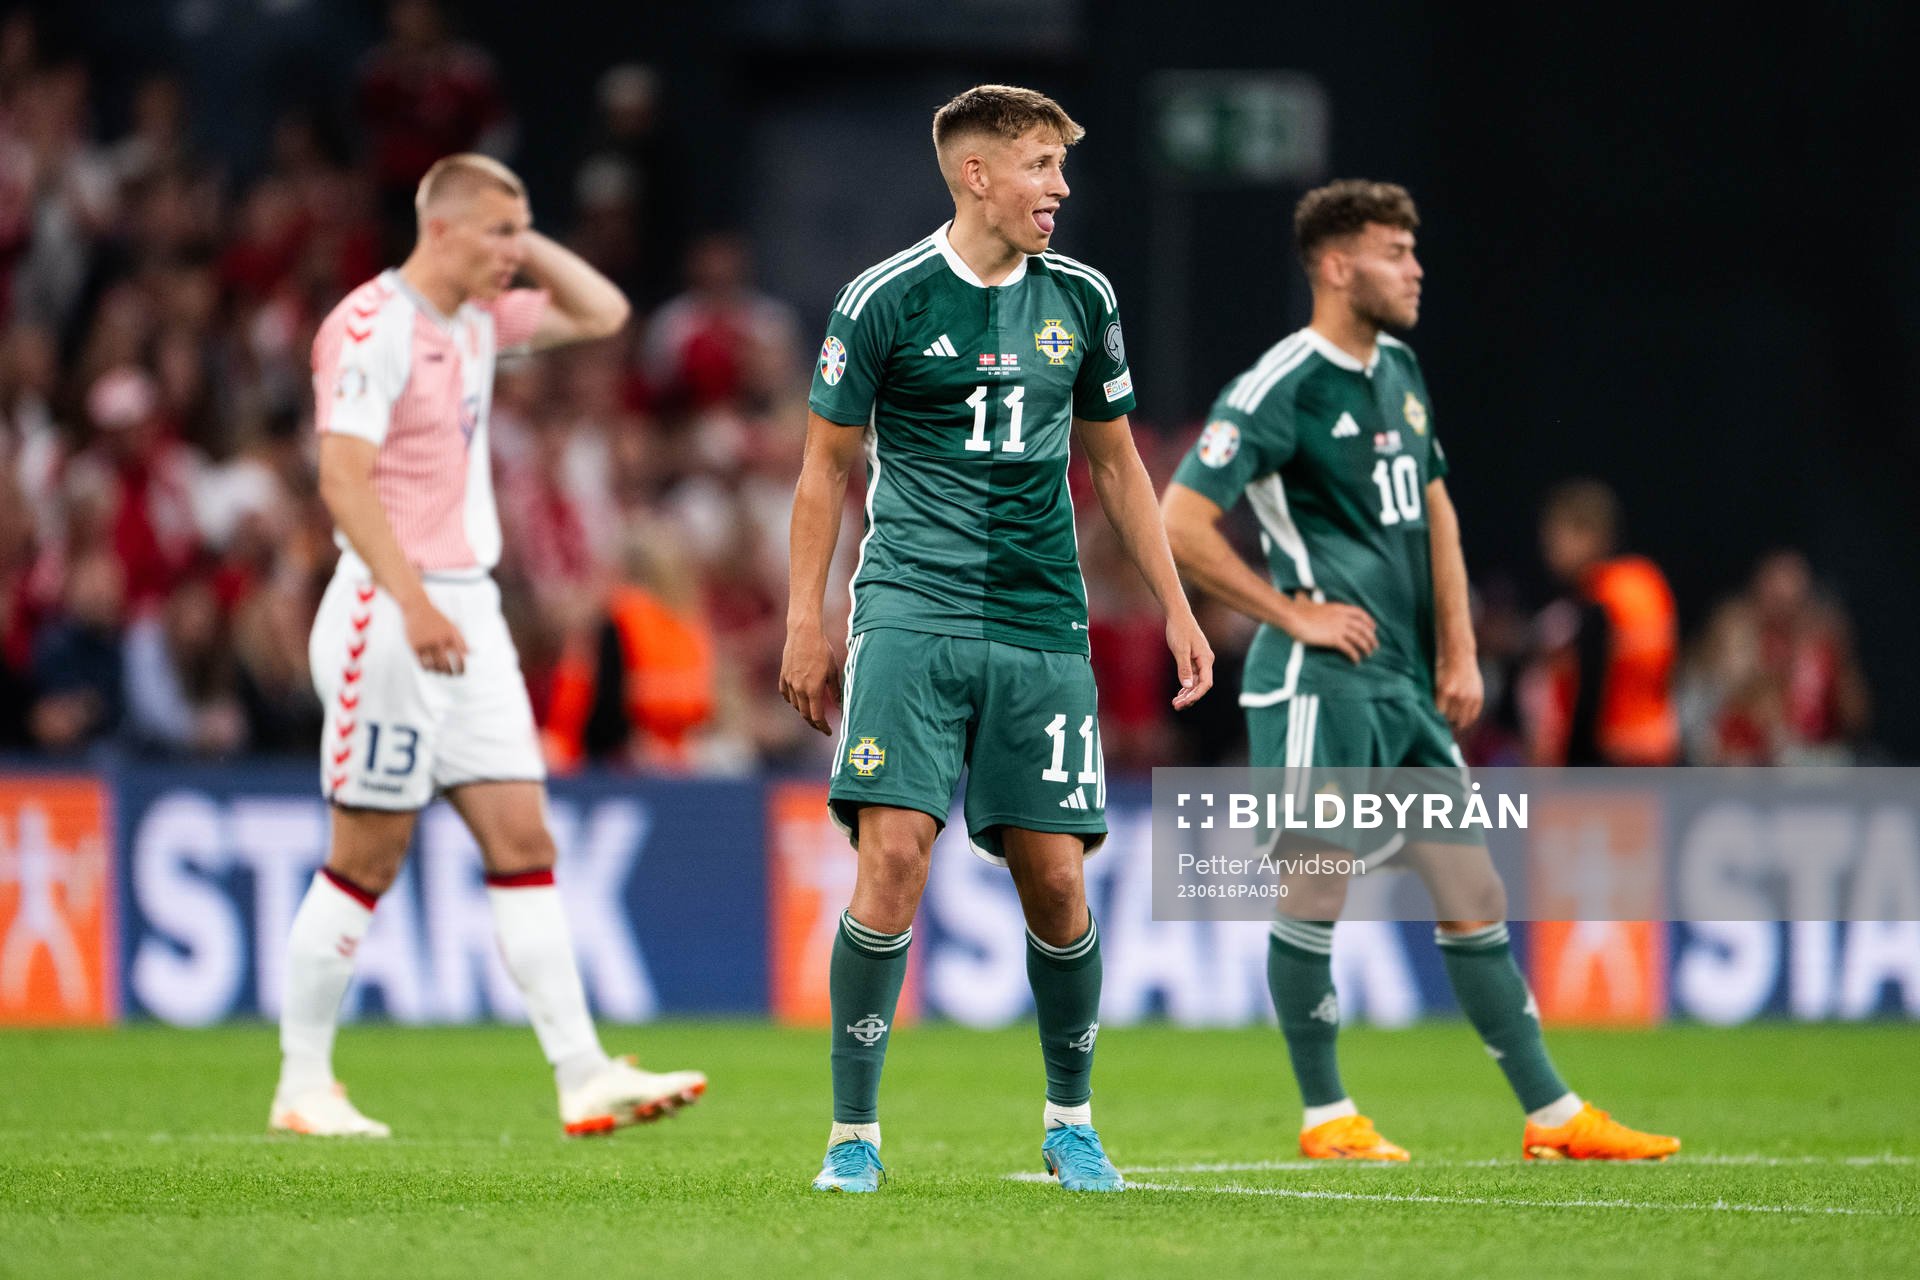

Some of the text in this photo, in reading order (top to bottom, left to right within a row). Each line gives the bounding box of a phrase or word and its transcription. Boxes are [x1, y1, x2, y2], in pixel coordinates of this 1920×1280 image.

[964, 386, 1025, 453] 11
[1372, 455, 1421, 526] 10
[364, 722, 418, 777] 13
[1041, 713, 1097, 783] 11
